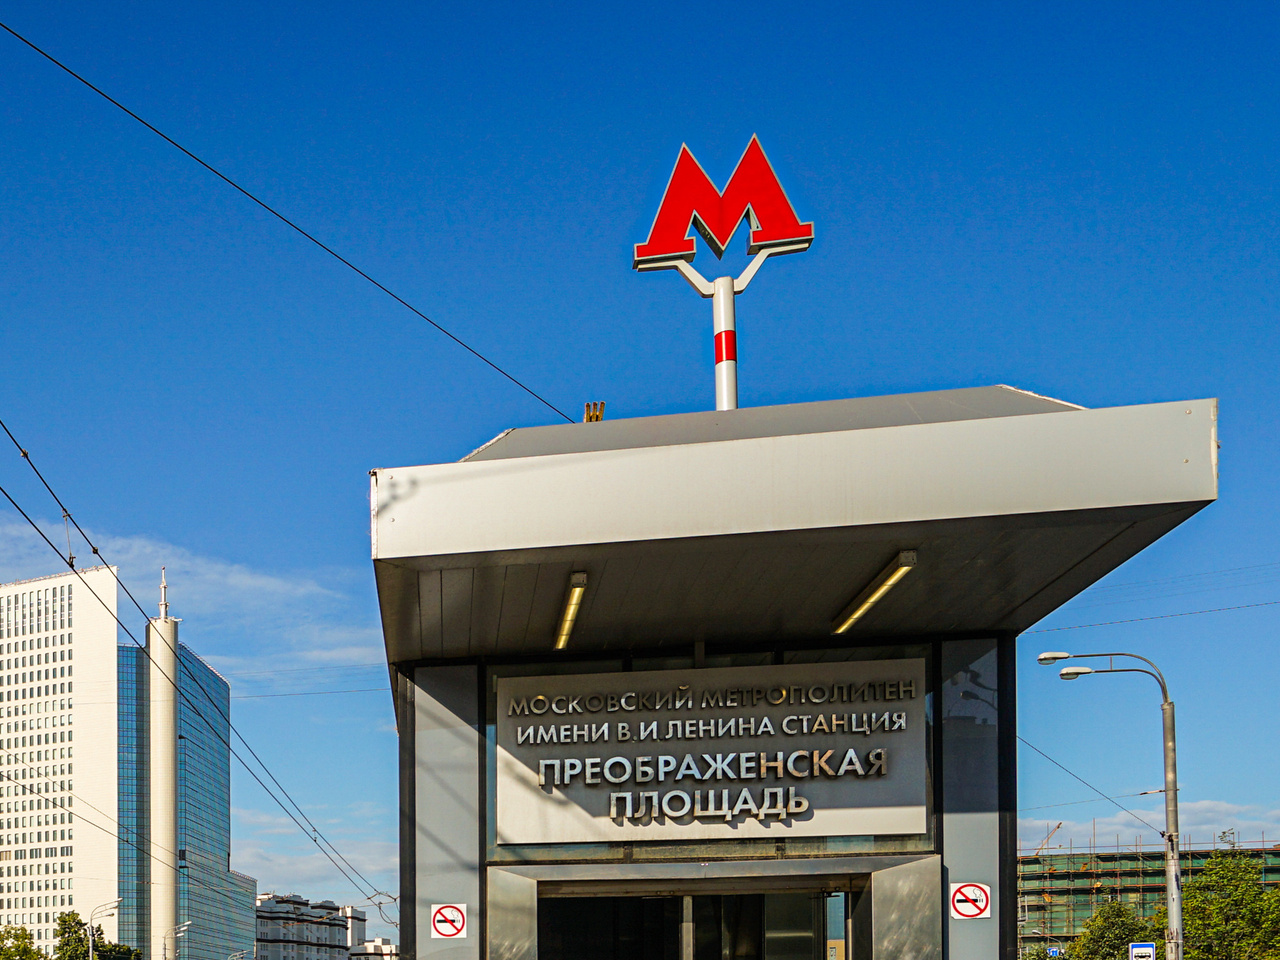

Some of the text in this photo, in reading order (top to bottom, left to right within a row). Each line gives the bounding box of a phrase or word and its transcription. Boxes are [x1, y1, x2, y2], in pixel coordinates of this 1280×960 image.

[633, 132, 814, 268] М
[508, 680, 917, 716] МОСКОВСКИЙ МЕТРОПОЛИТЕН
[516, 721, 609, 745] ИМЕНИ
[781, 711, 907, 735] СТАНЦИЯ
[538, 748, 888, 786] ПРЕОБРАЖЕНСКАЯ
[609, 786, 810, 822] ПЛОЩАДЬ
